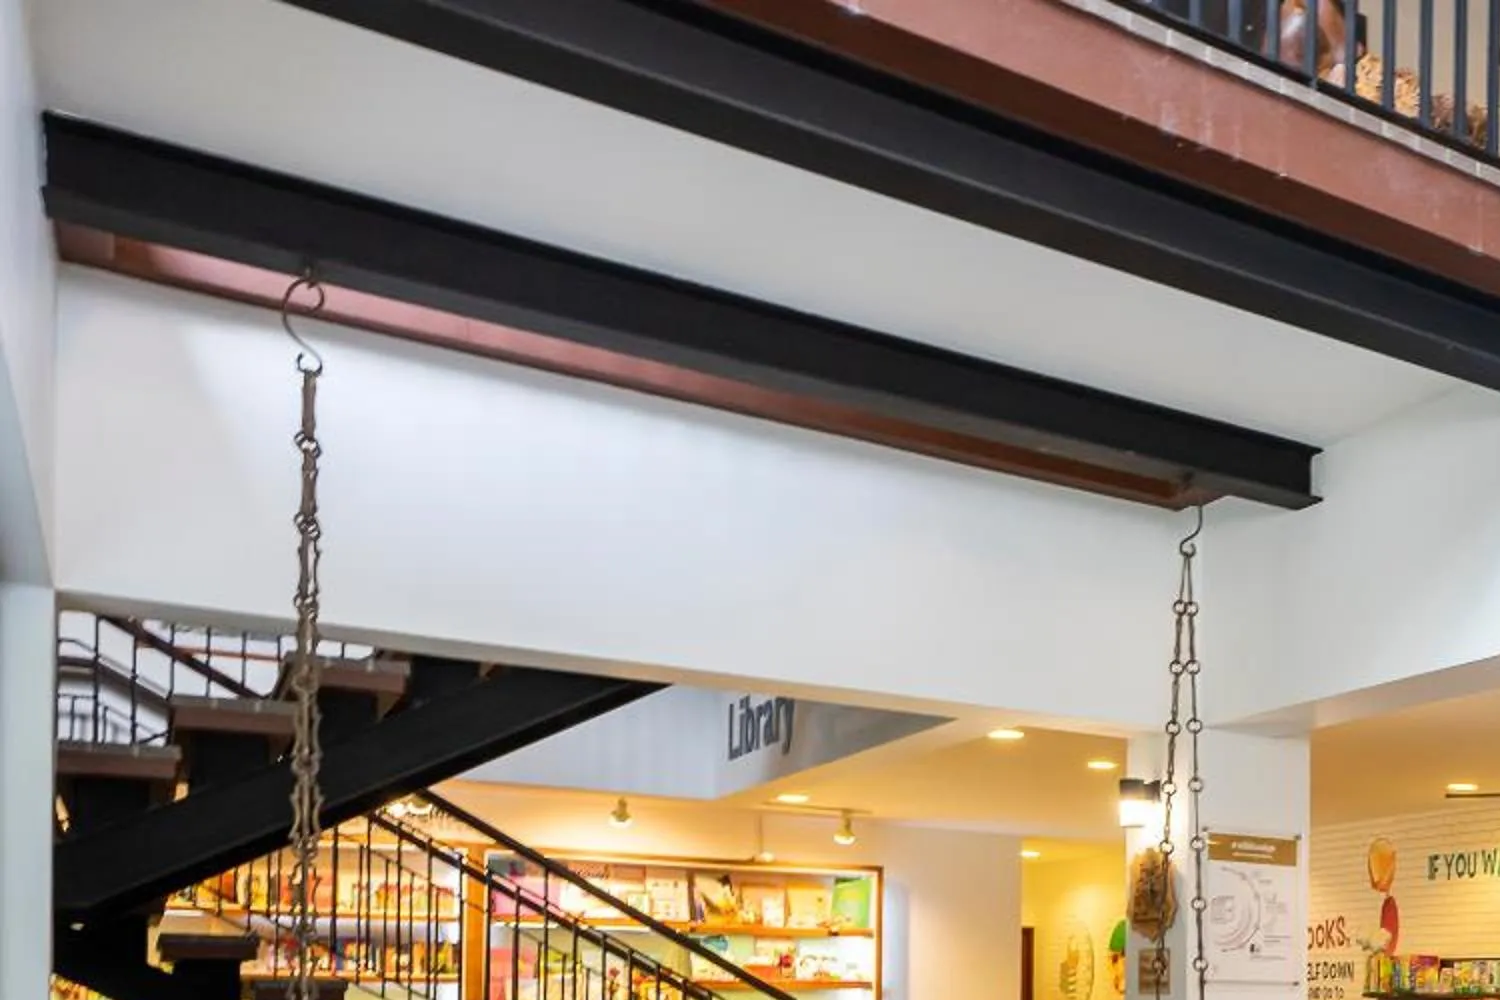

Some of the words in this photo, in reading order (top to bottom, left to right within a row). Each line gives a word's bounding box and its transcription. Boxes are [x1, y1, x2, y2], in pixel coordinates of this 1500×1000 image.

[728, 694, 795, 760] Library
[1427, 853, 1439, 881] IF
[1444, 851, 1478, 881] YOU
